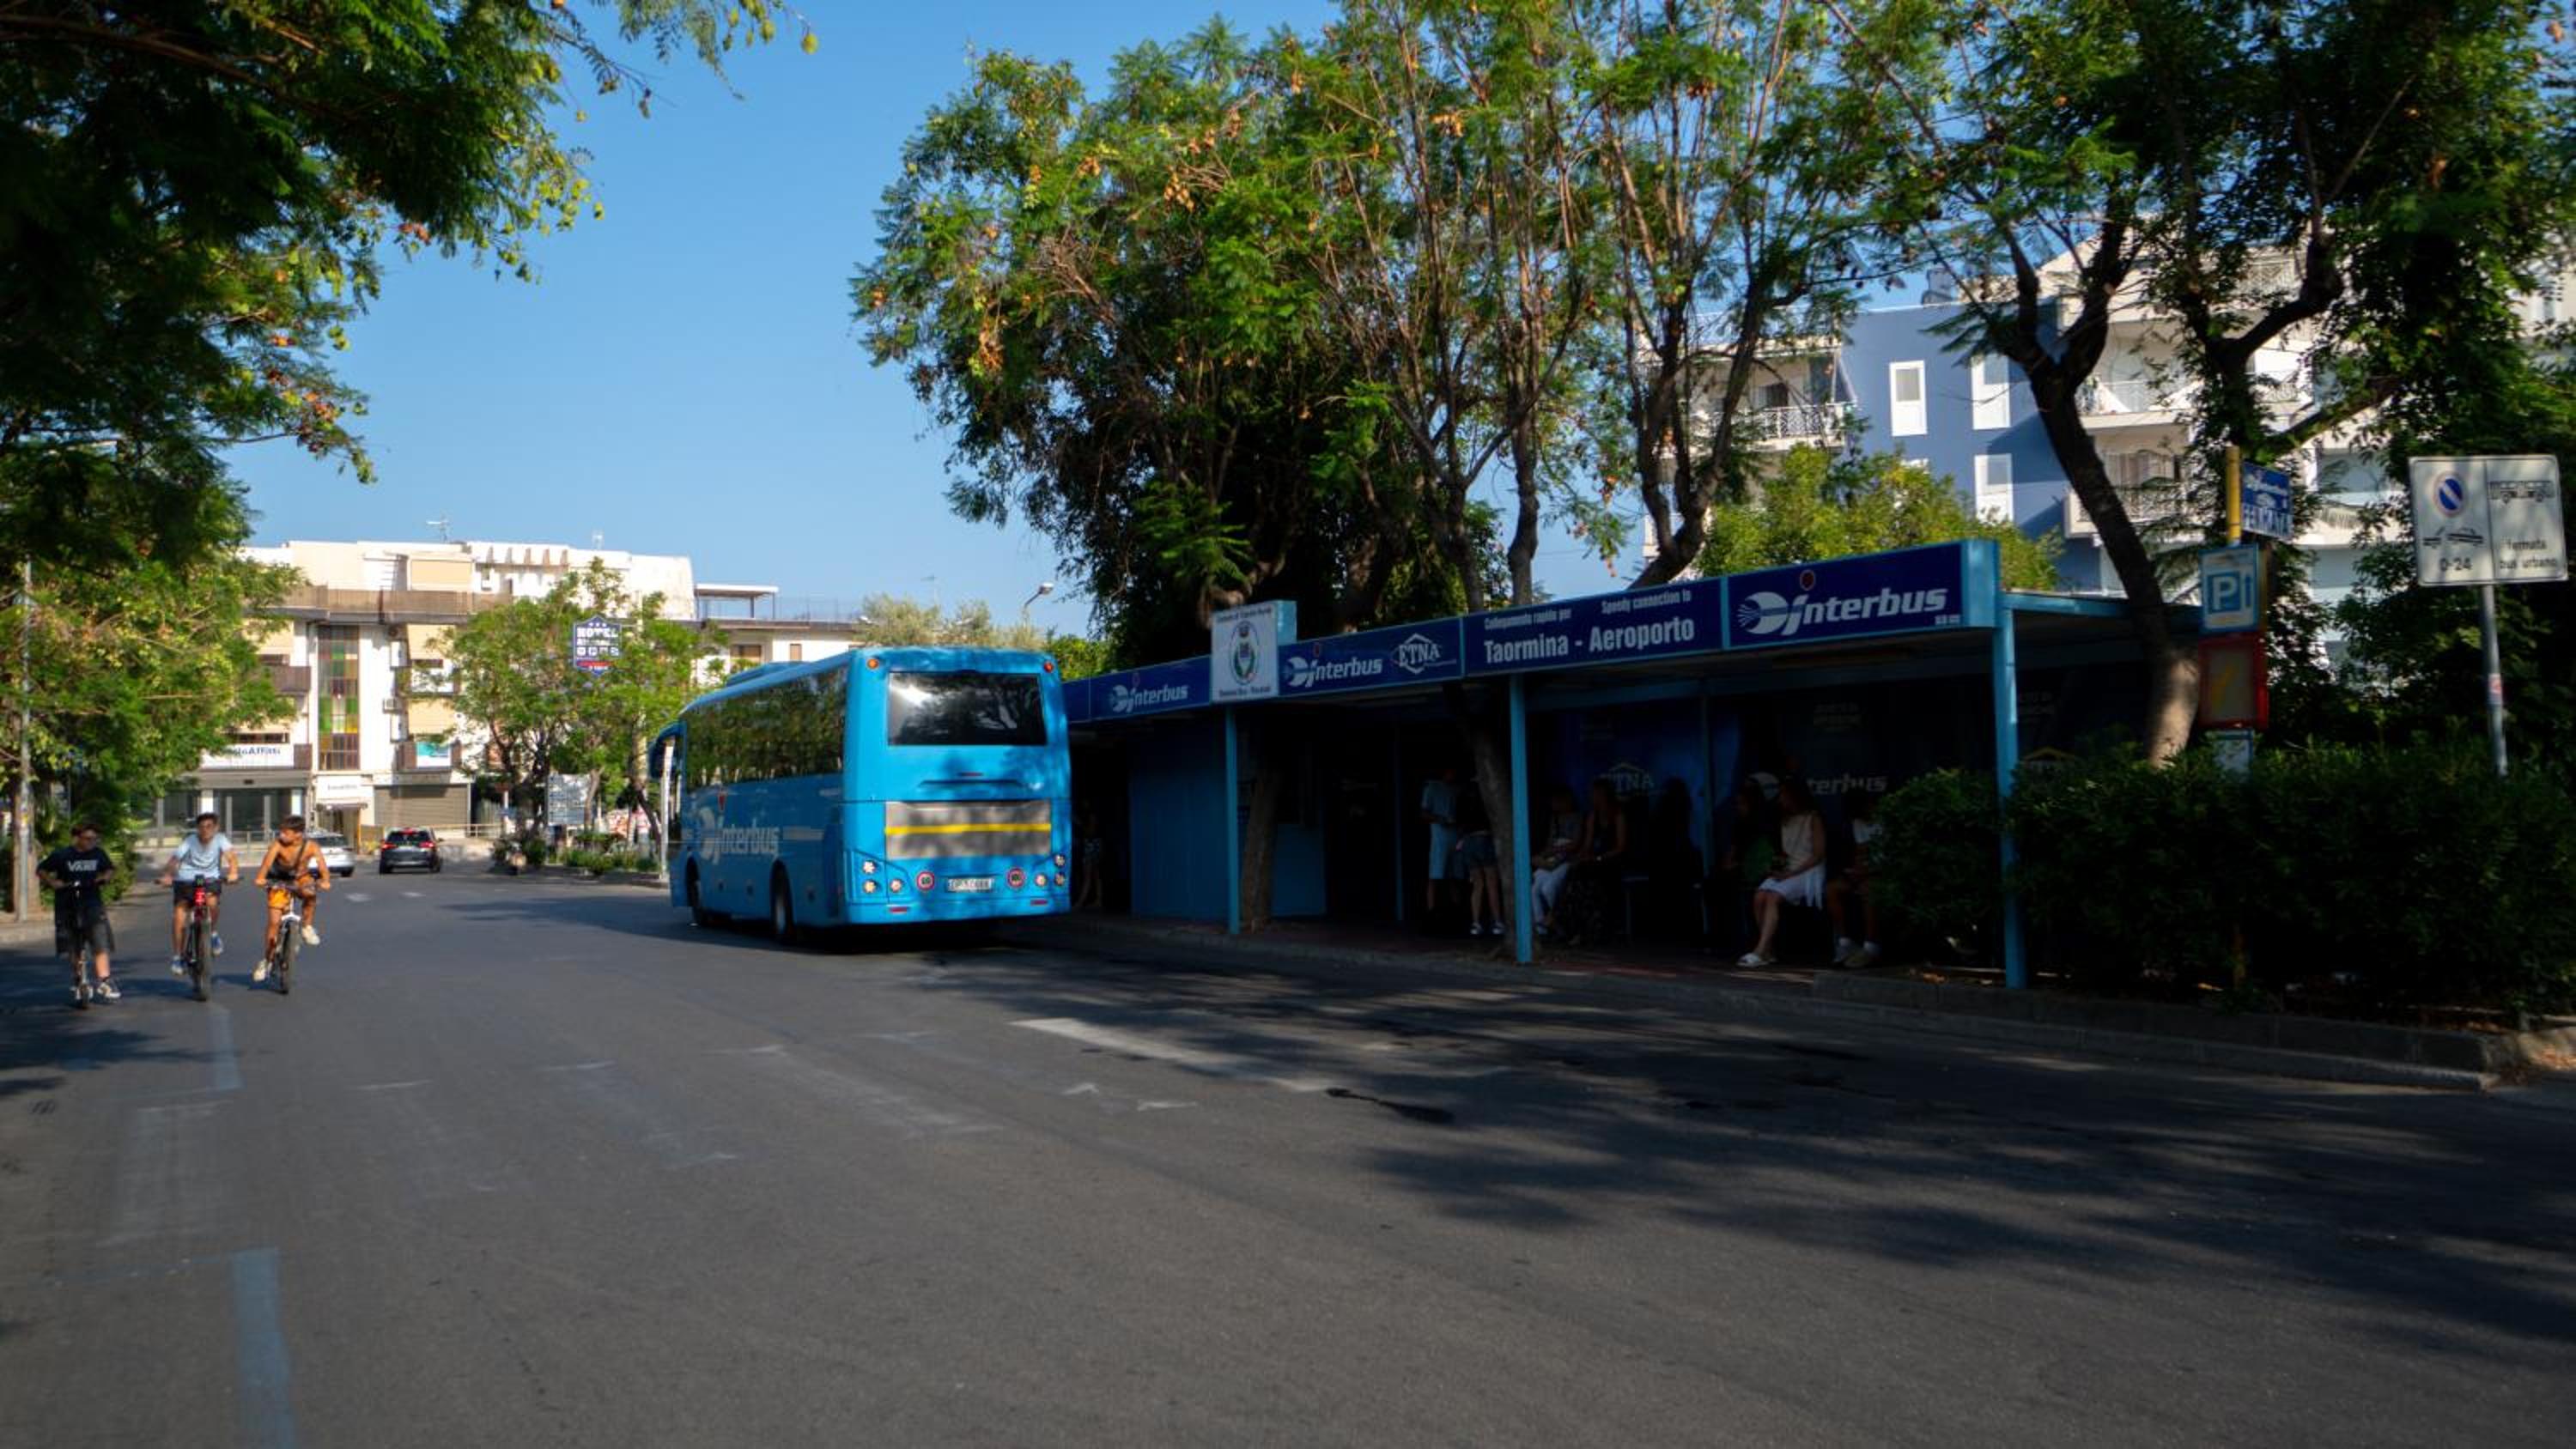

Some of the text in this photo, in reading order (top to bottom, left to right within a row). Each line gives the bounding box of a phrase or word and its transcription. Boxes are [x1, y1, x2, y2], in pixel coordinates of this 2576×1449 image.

[2439, 557, 2473, 572] 0-24
[1483, 633, 1570, 664] Taormina
[1588, 616, 1696, 652] Aeroporto
[1398, 642, 1442, 667] ETNA
